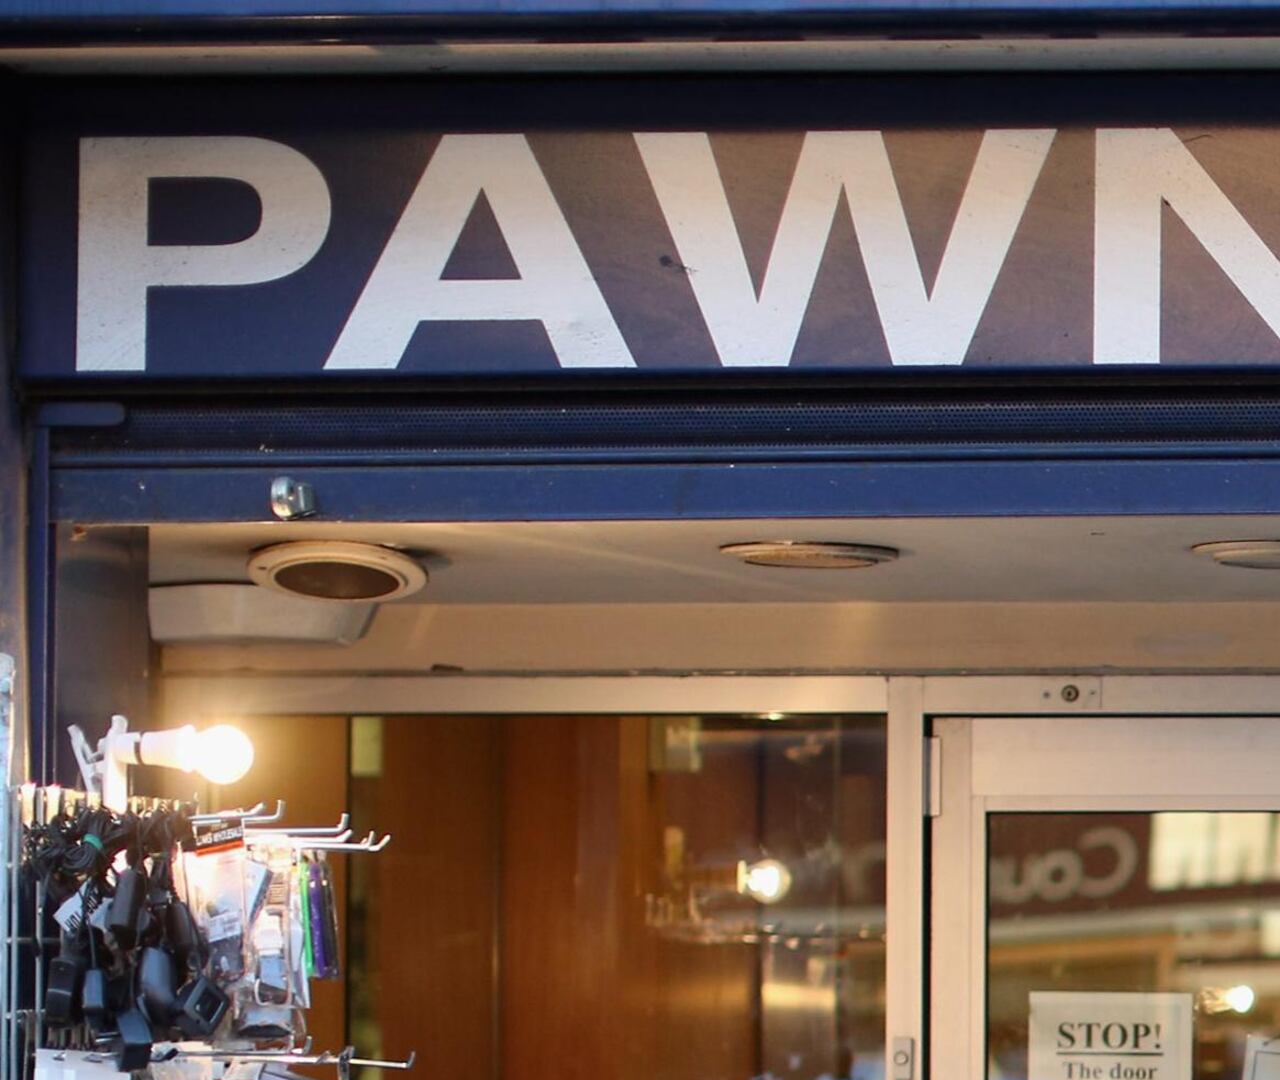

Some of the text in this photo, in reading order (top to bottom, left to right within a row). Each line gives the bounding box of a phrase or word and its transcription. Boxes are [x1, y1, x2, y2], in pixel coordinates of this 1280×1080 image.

[1057, 1022, 1161, 1049] STOP!
[1064, 1062, 1158, 1080] The door
